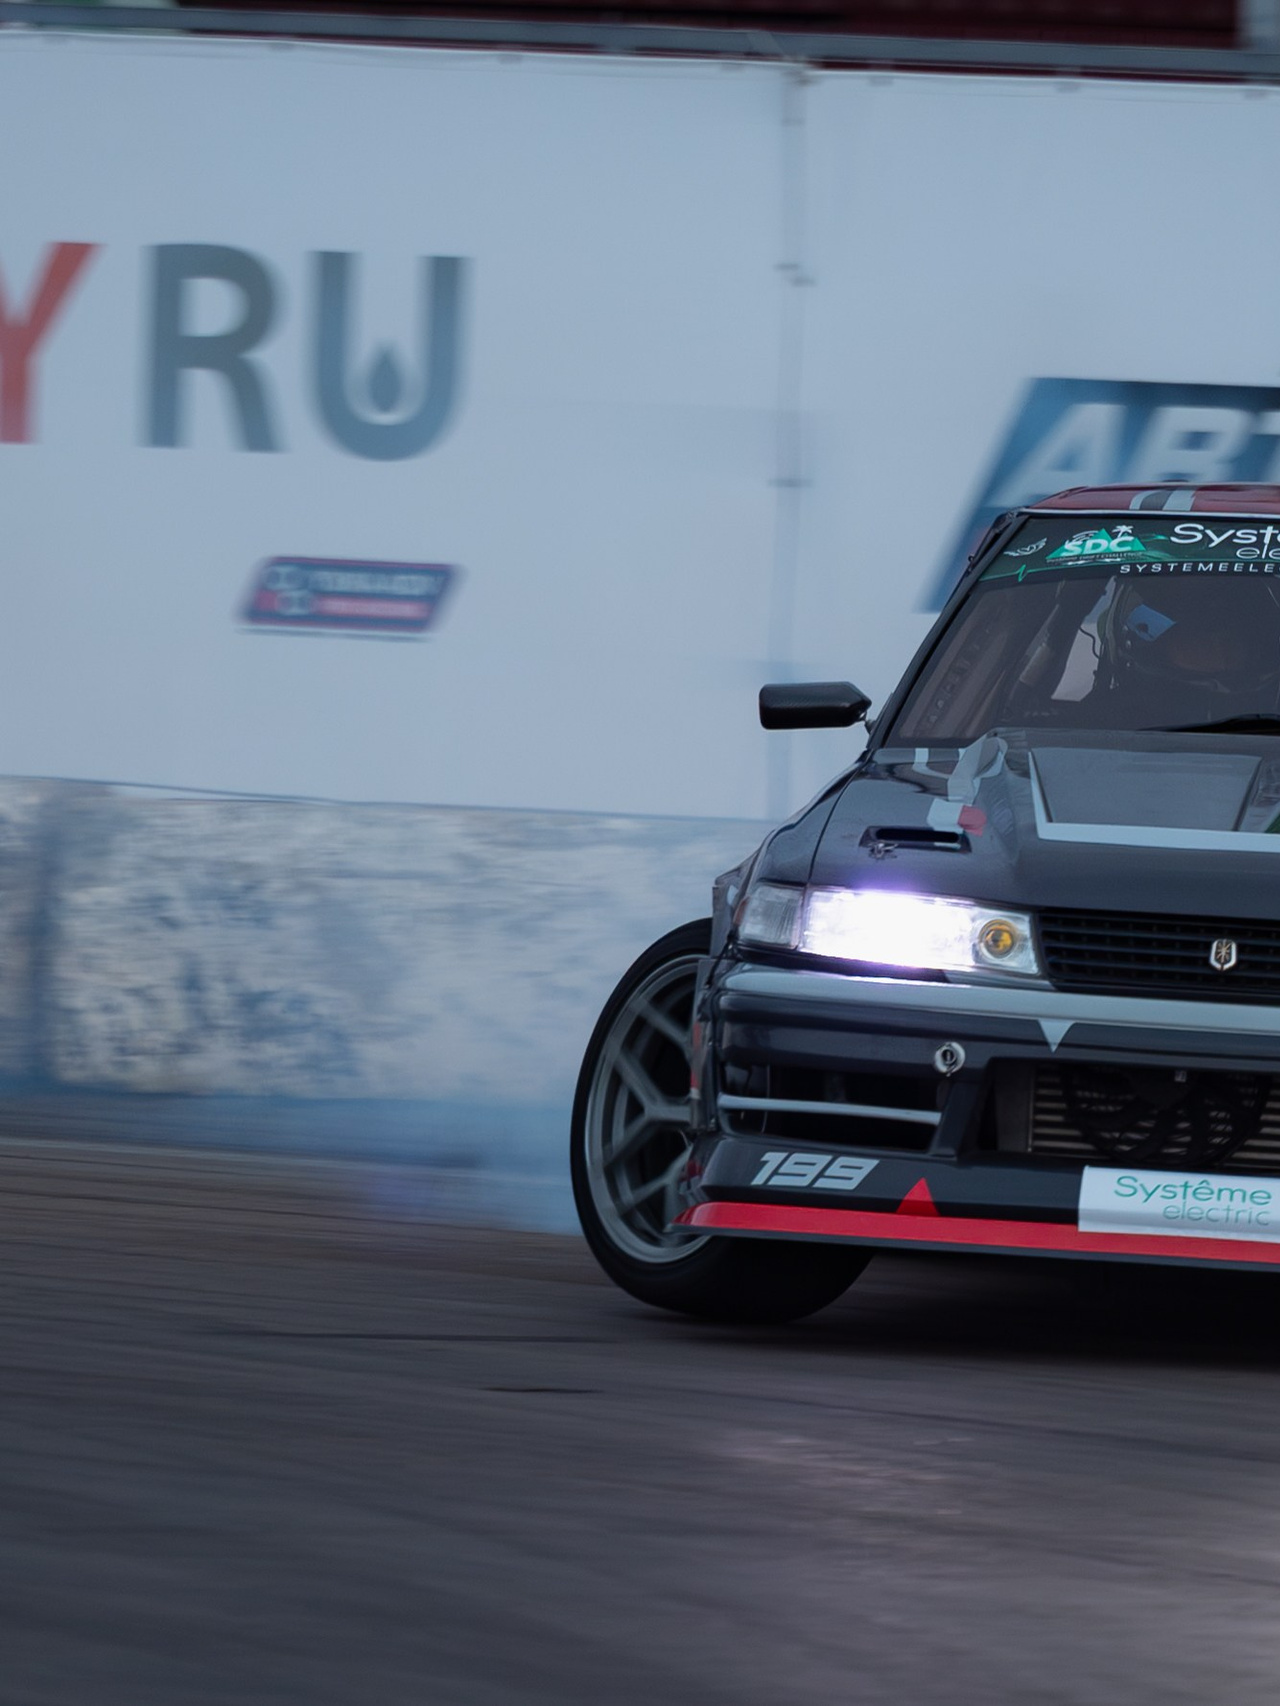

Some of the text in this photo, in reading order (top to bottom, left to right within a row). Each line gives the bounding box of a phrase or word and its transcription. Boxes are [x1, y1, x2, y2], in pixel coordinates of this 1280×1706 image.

[1060, 536, 1134, 557] SDC
[750, 1151, 881, 1191] 199
[1114, 1175, 1272, 1206] Systême
[1162, 1202, 1271, 1226] electric
